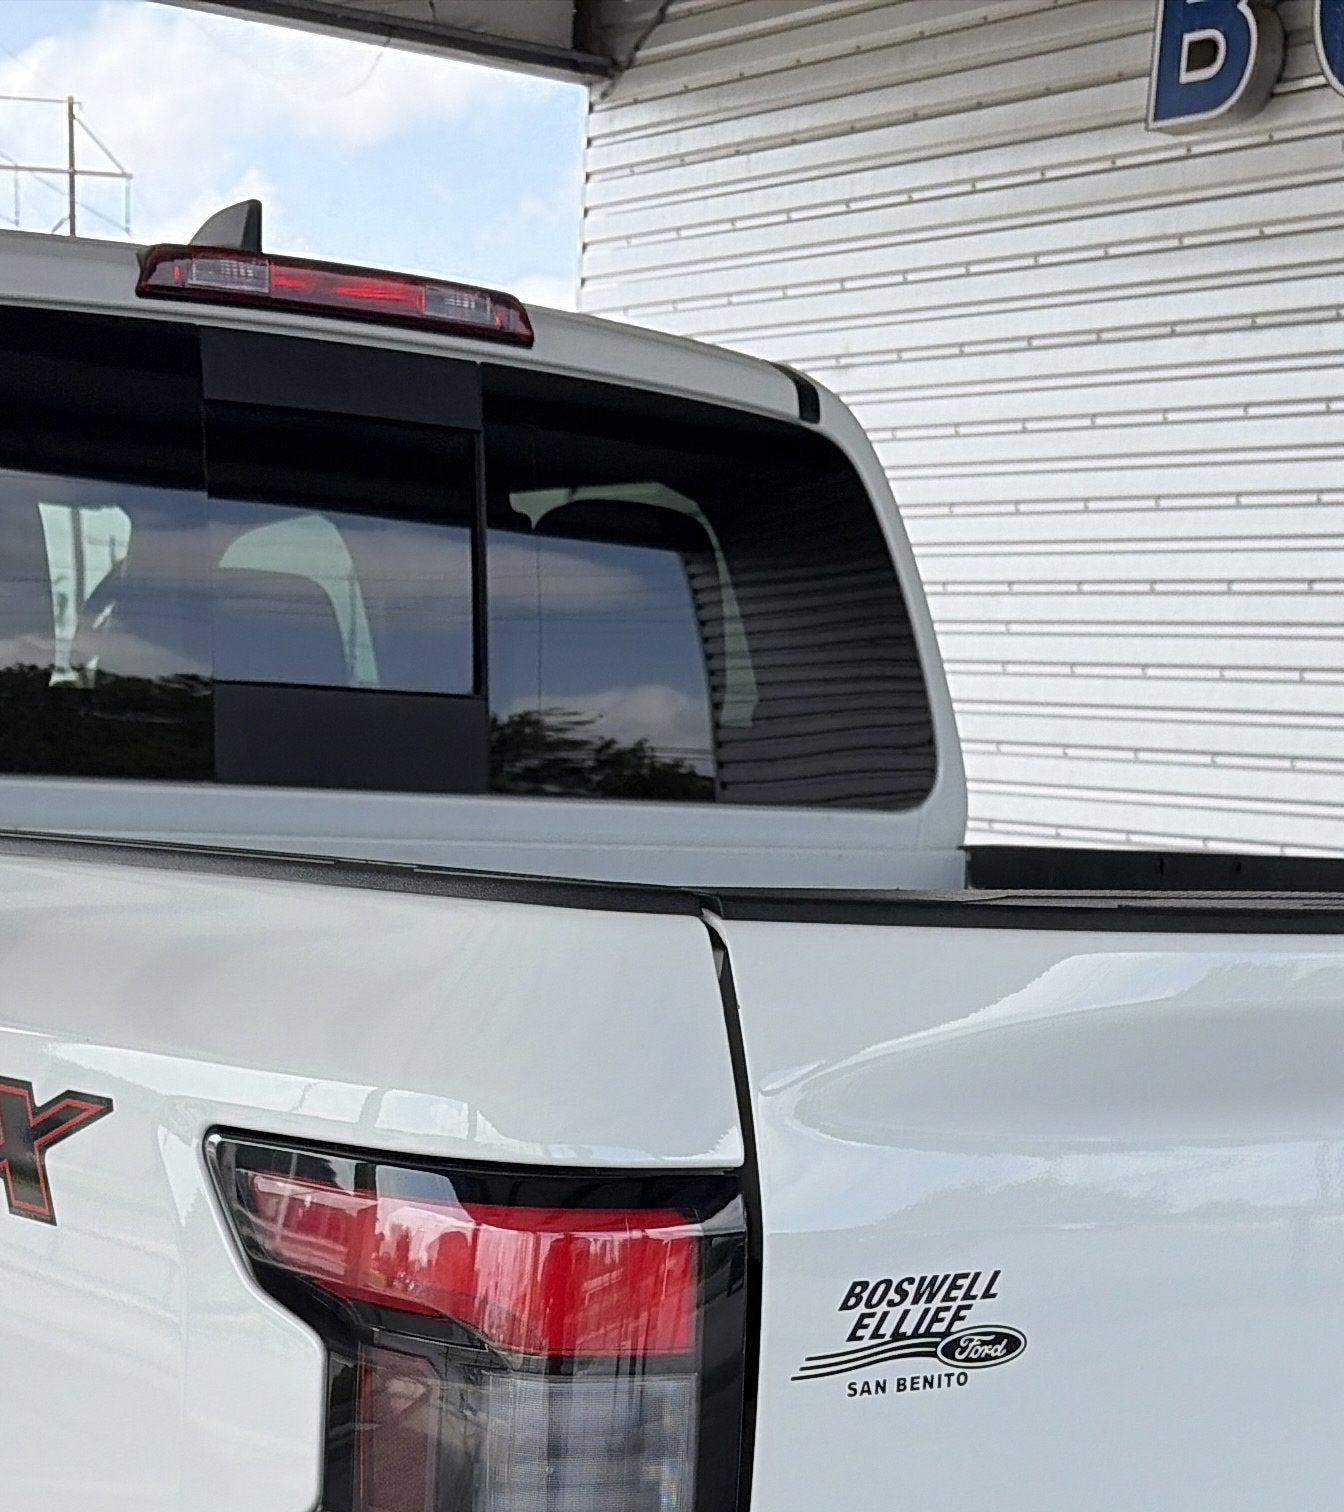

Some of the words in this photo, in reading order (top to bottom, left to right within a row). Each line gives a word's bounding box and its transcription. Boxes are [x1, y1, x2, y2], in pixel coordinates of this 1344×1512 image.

[838, 1270, 1001, 1312] BOSWELL
[846, 1304, 974, 1342] ELLIFF
[955, 1333, 1007, 1359] Ford
[847, 1379, 887, 1398] SAN
[896, 1371, 968, 1393] BENITO
